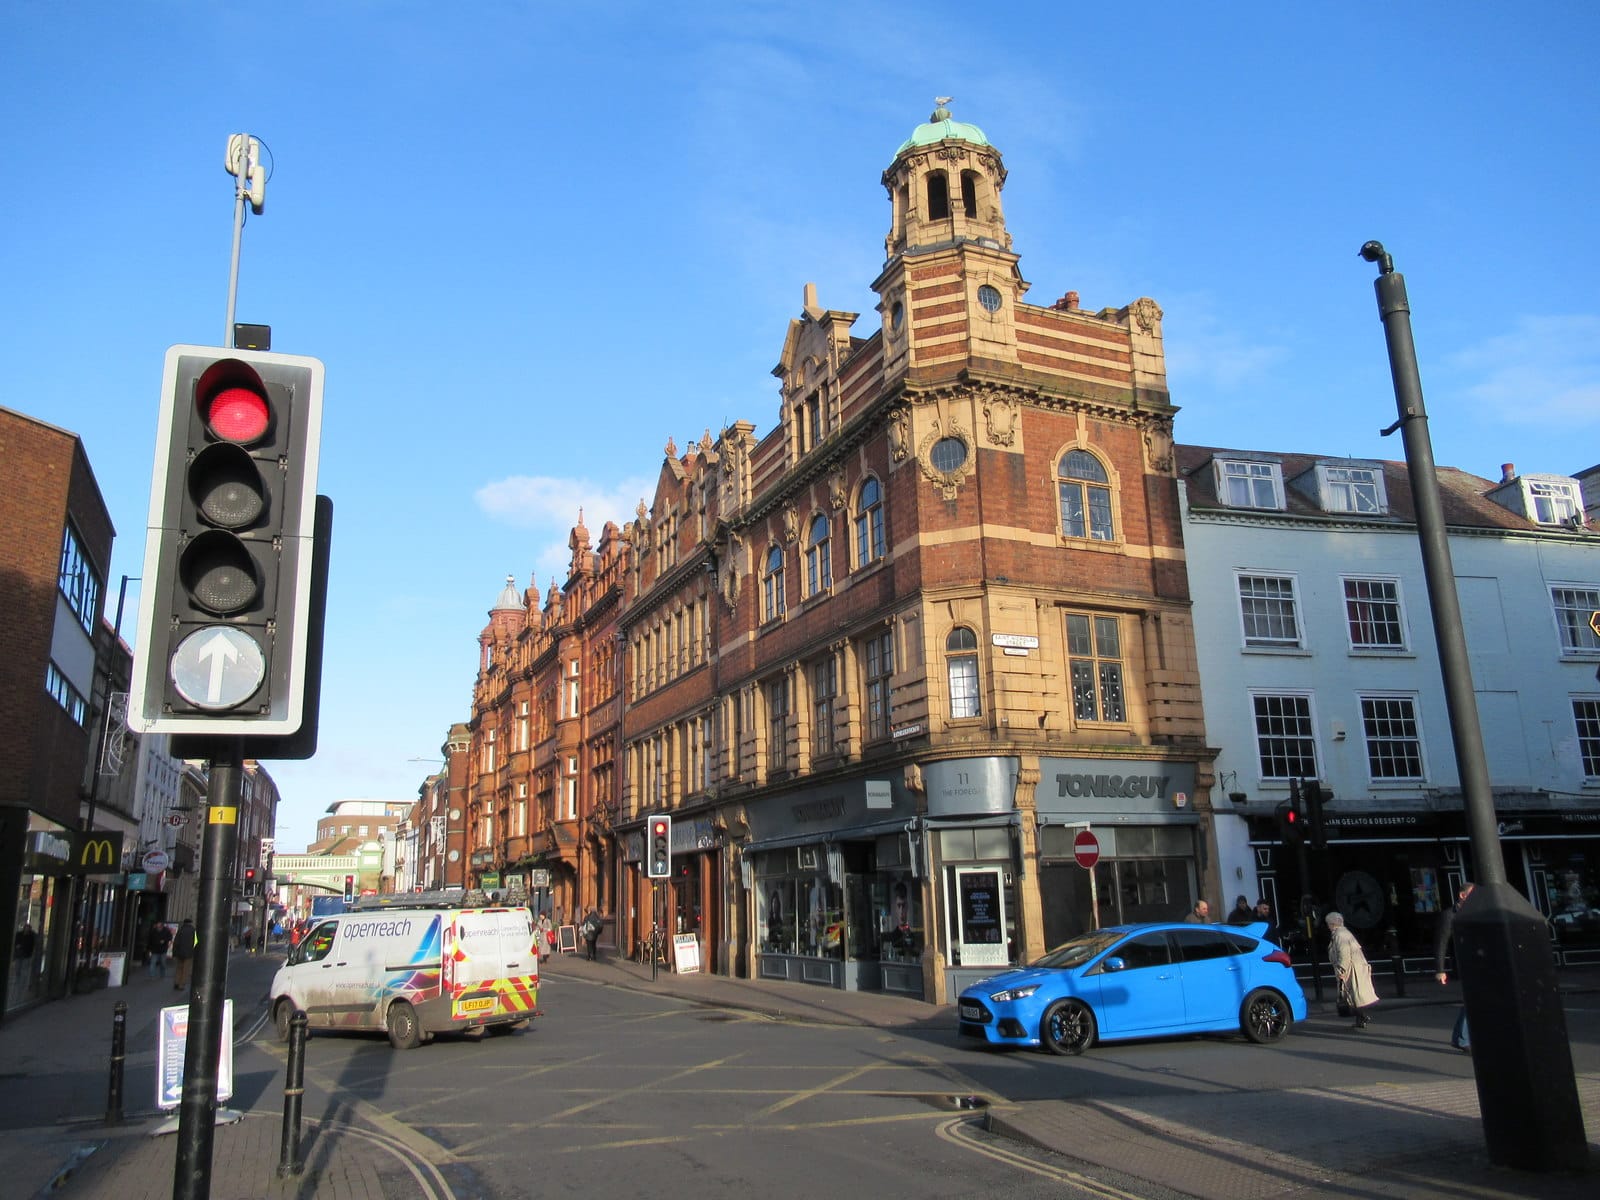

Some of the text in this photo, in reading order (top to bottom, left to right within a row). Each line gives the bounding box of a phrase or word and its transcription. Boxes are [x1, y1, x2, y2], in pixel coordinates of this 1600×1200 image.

[957, 773, 969, 785] 11
[1056, 774, 1171, 798] TONI&GUY
[1342, 818, 1367, 826] GELATO
[1374, 817, 1405, 825] DESSERT
[1406, 816, 1416, 824] CO
[344, 918, 412, 941] openreach
